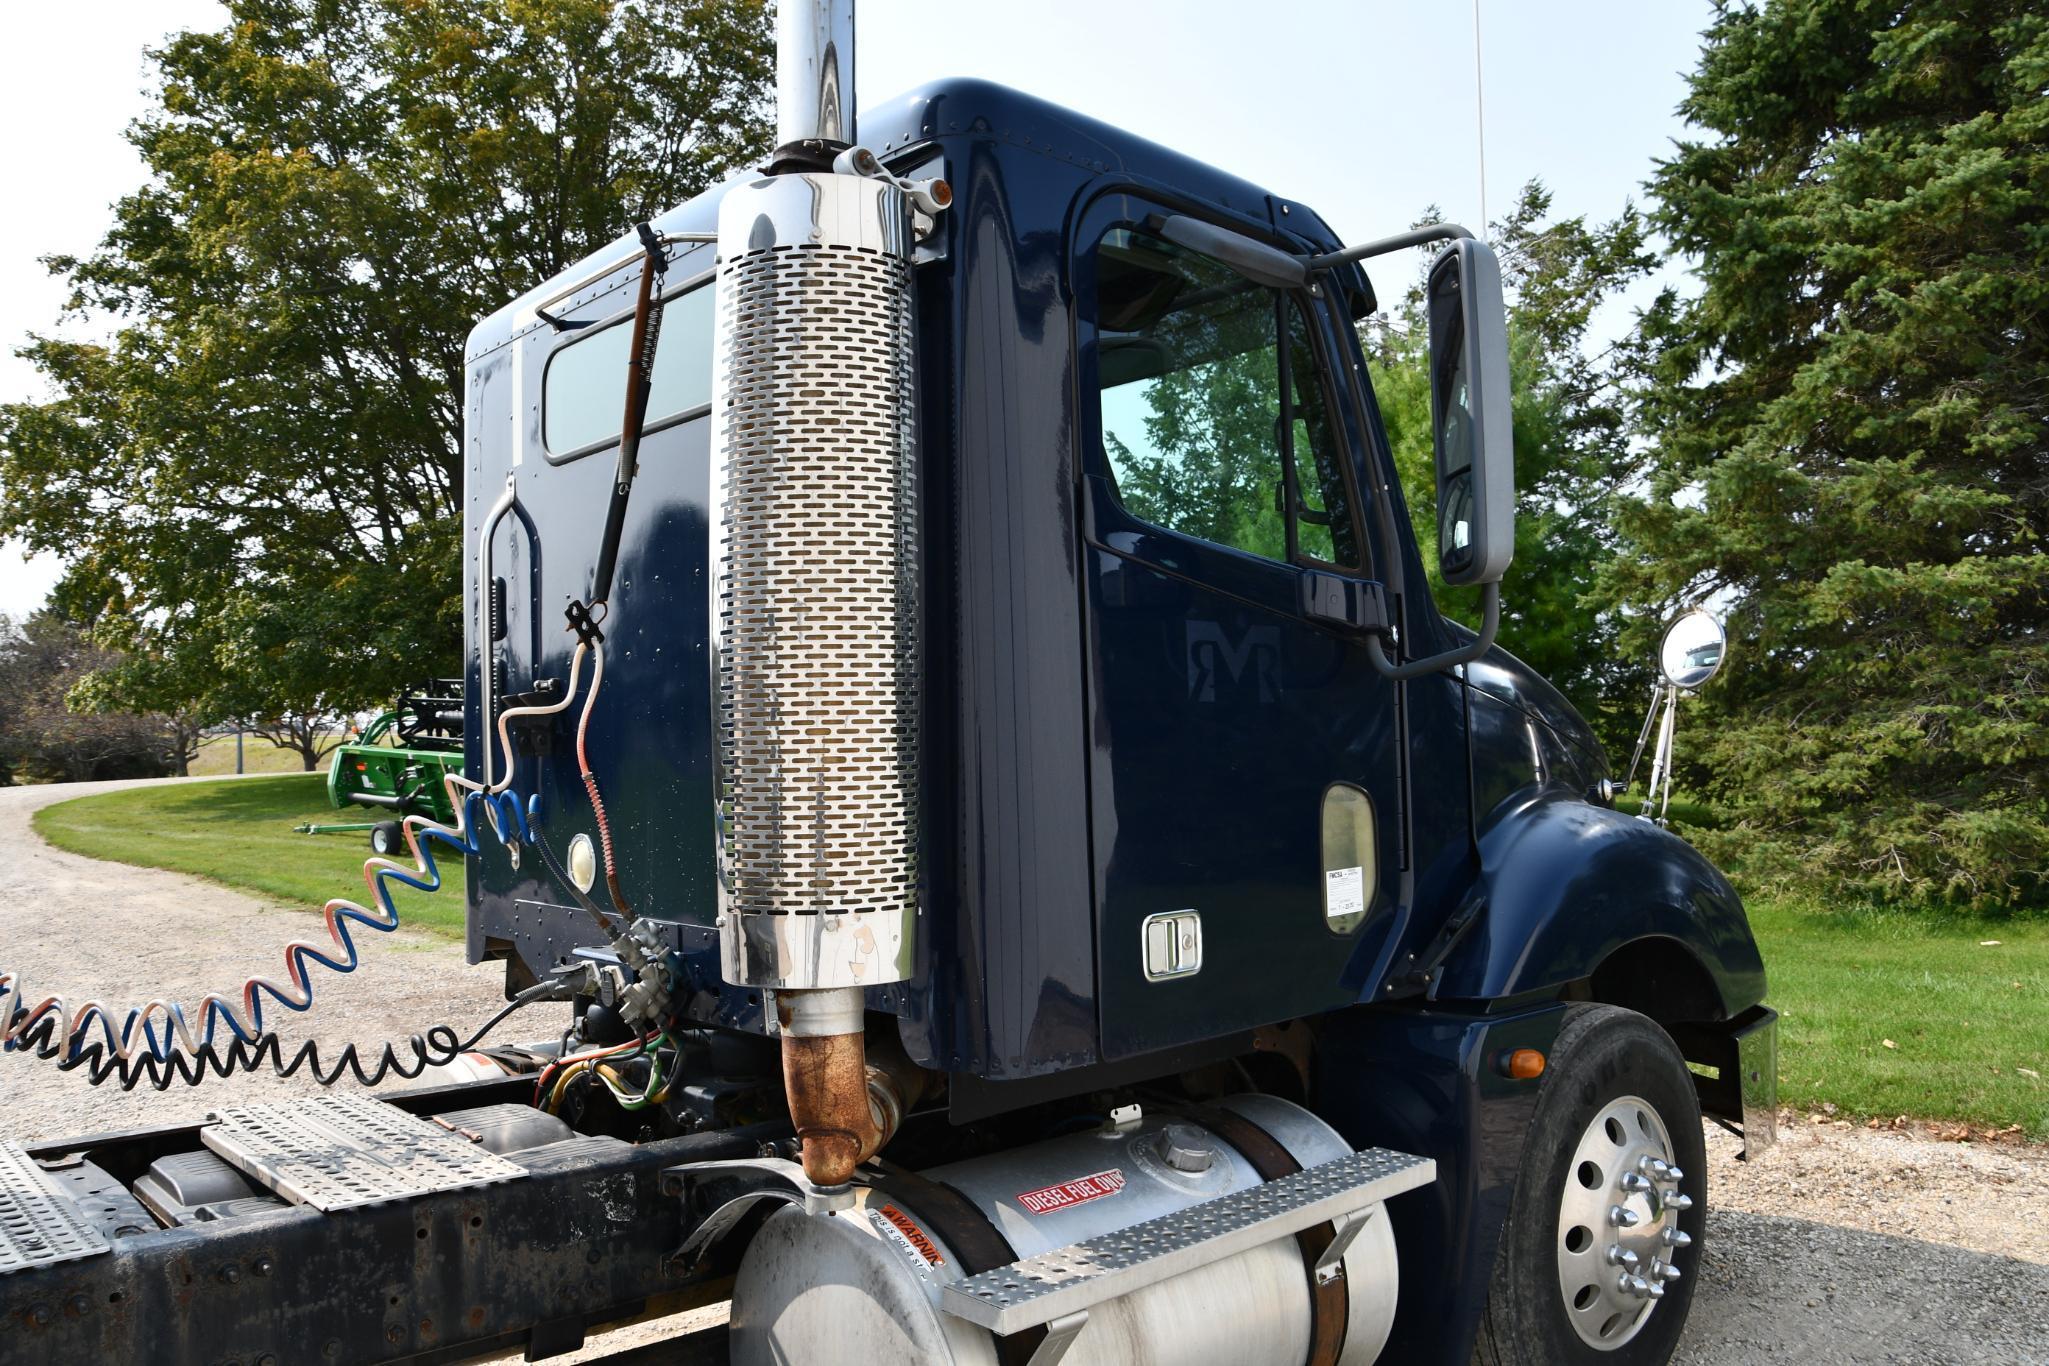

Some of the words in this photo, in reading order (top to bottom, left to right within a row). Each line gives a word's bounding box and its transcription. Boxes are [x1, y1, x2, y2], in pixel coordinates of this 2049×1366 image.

[1024, 1186, 1073, 1211] DIESEL
[1067, 1180, 1102, 1199] FUEL
[870, 1212, 888, 1226] This
[886, 1226, 896, 1234] is
[894, 1235, 910, 1249] not
